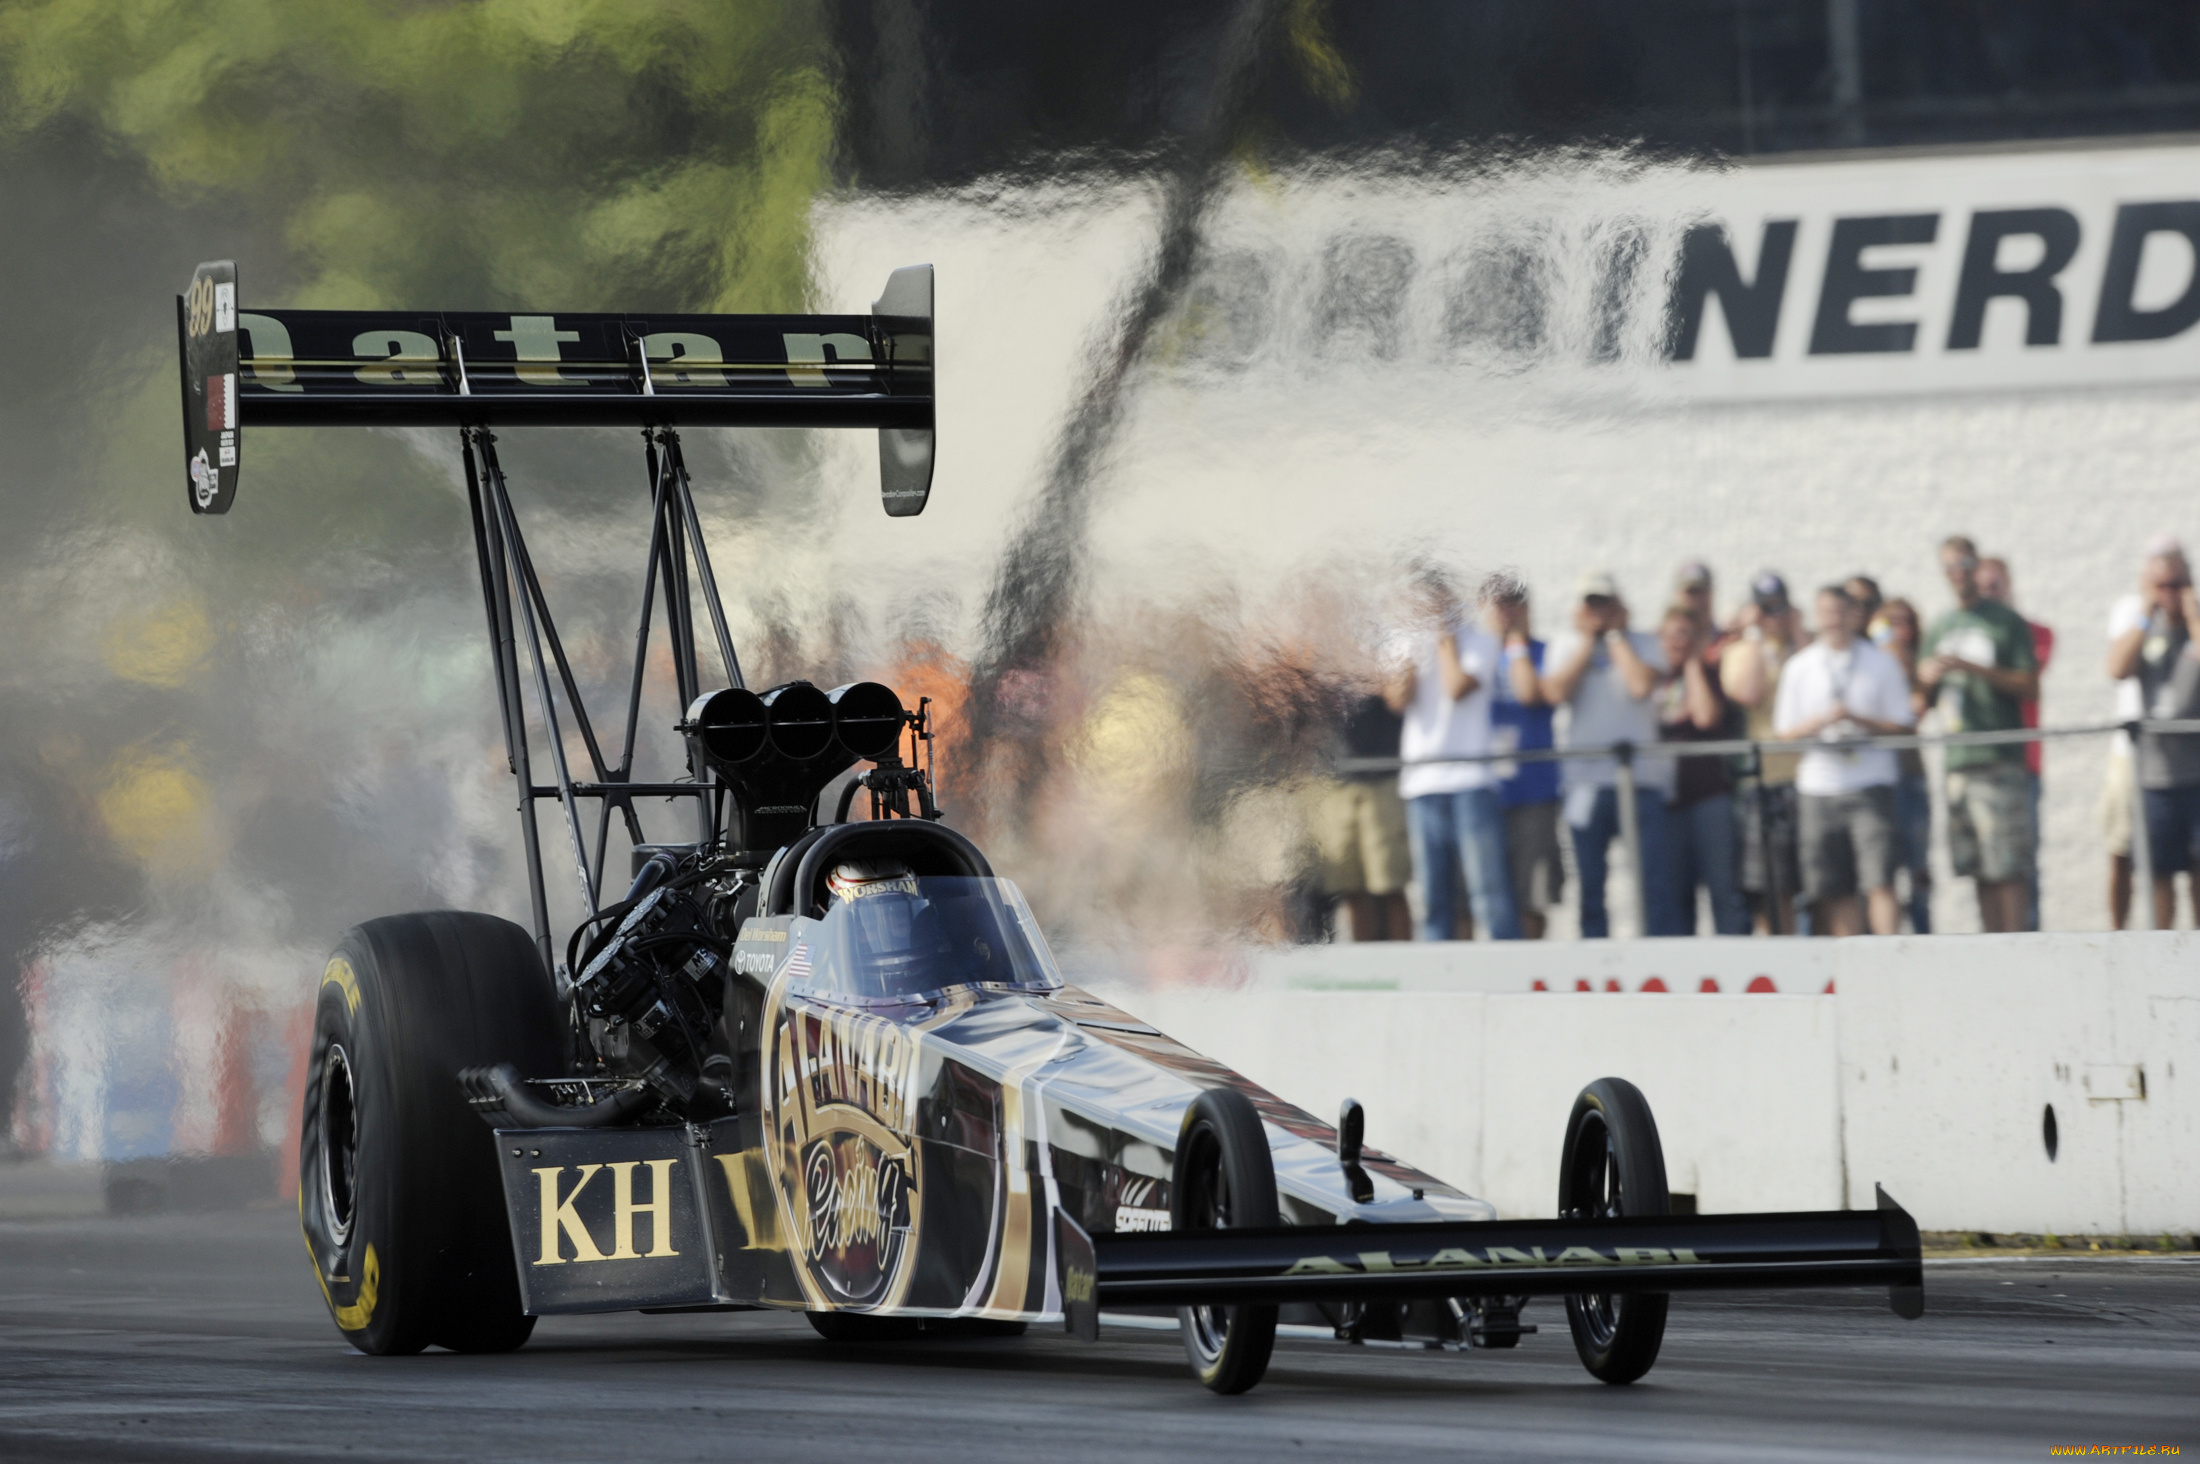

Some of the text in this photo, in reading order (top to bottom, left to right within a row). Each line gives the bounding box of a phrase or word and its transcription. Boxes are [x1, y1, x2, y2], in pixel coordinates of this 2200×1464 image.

[189, 275, 214, 338] 99
[837, 880, 919, 905] WORSHAM
[746, 953, 775, 973] TOYOTA
[532, 1158, 680, 1267] KH
[804, 1134, 900, 1271] Racing
